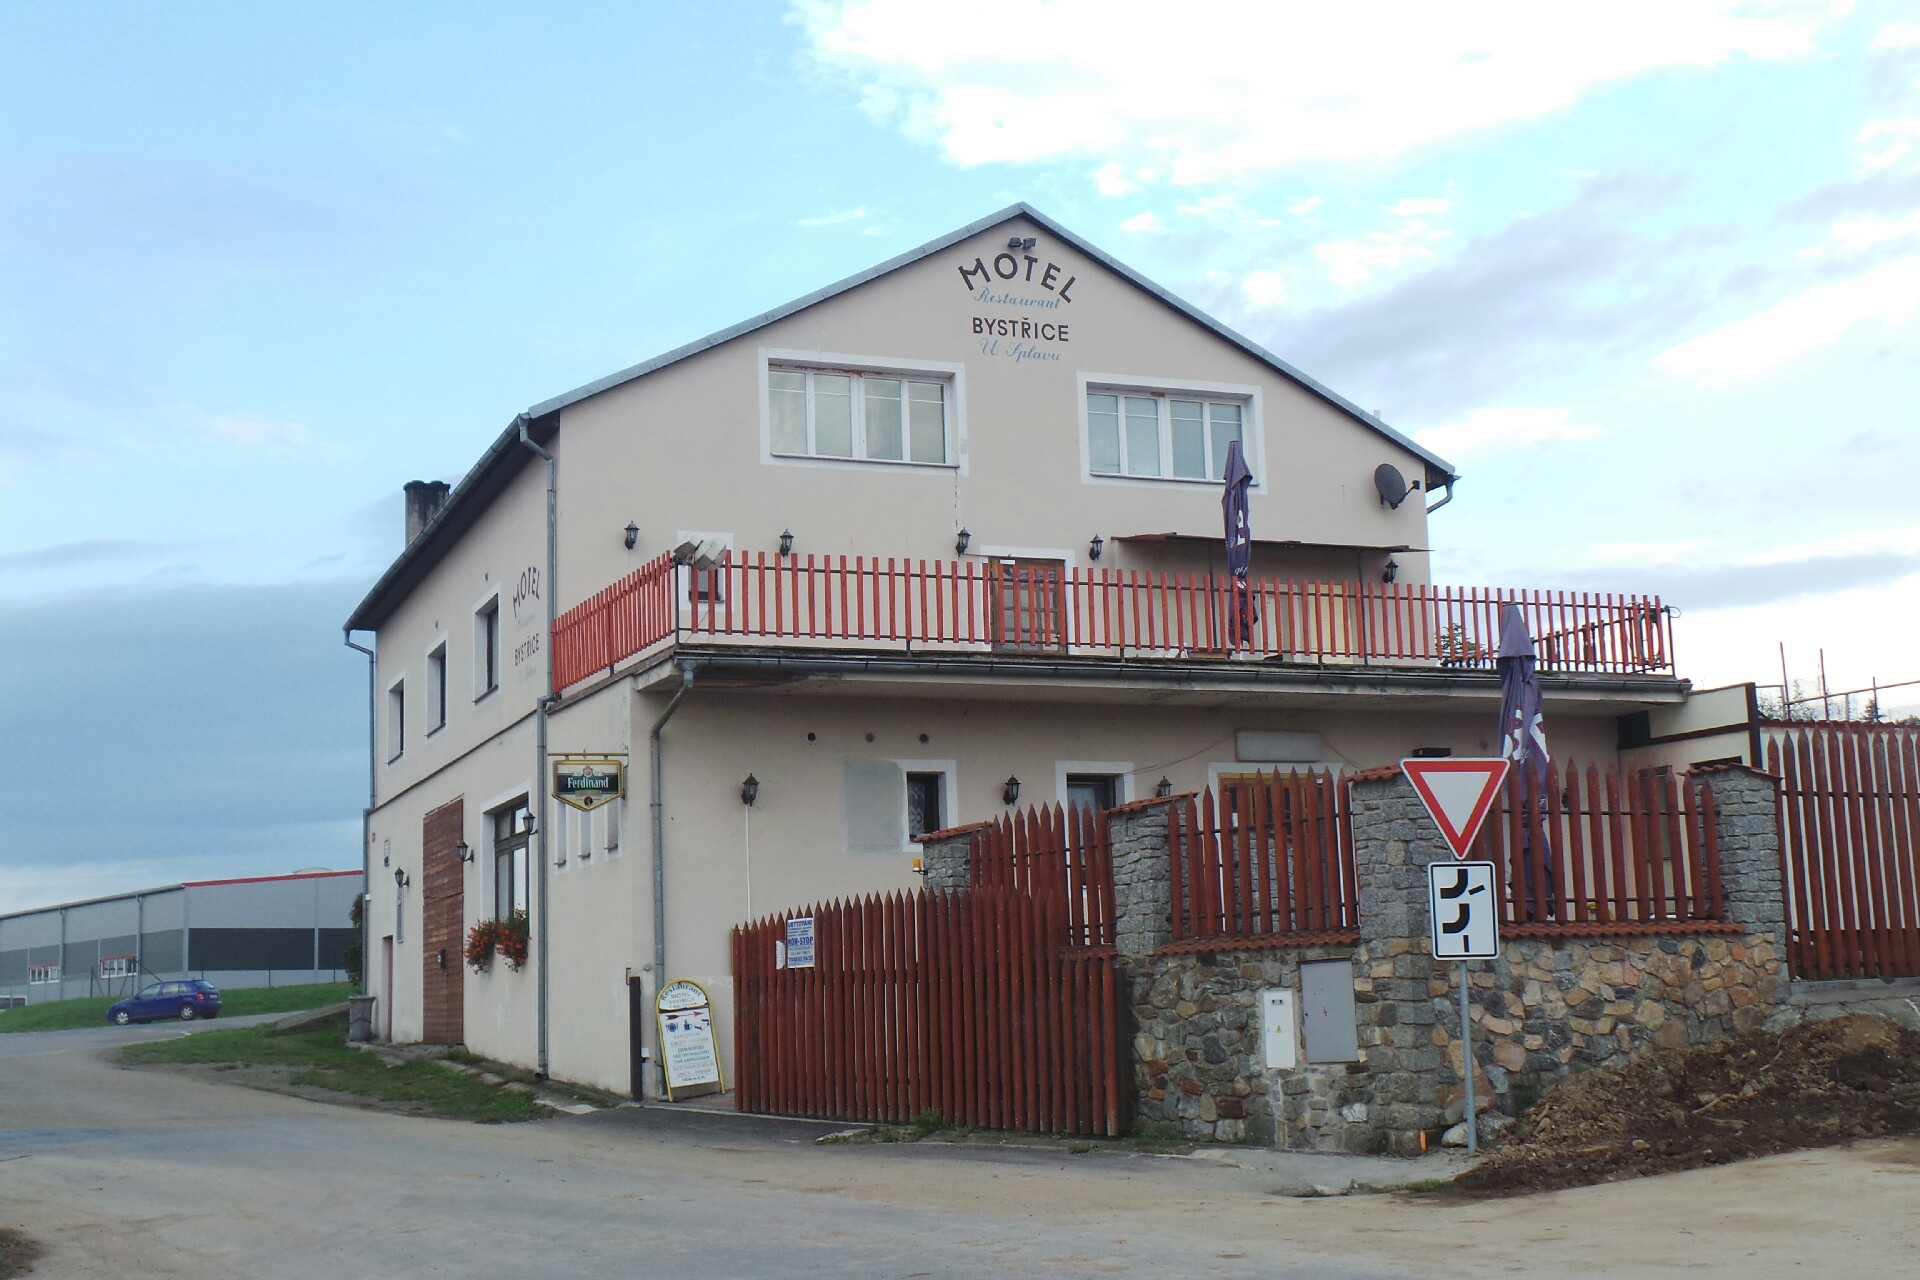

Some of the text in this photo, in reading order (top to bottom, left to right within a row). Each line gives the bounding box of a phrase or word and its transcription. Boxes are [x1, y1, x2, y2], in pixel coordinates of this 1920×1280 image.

[958, 252, 1076, 304] MOTEL
[973, 286, 1062, 309] Restaurant
[972, 316, 1070, 342] BYSTŘICE
[979, 338, 1062, 363] U Splavu
[512, 565, 541, 619] MOTEL
[567, 776, 609, 789] Ferdinand
[787, 936, 814, 946] NON-STOP
